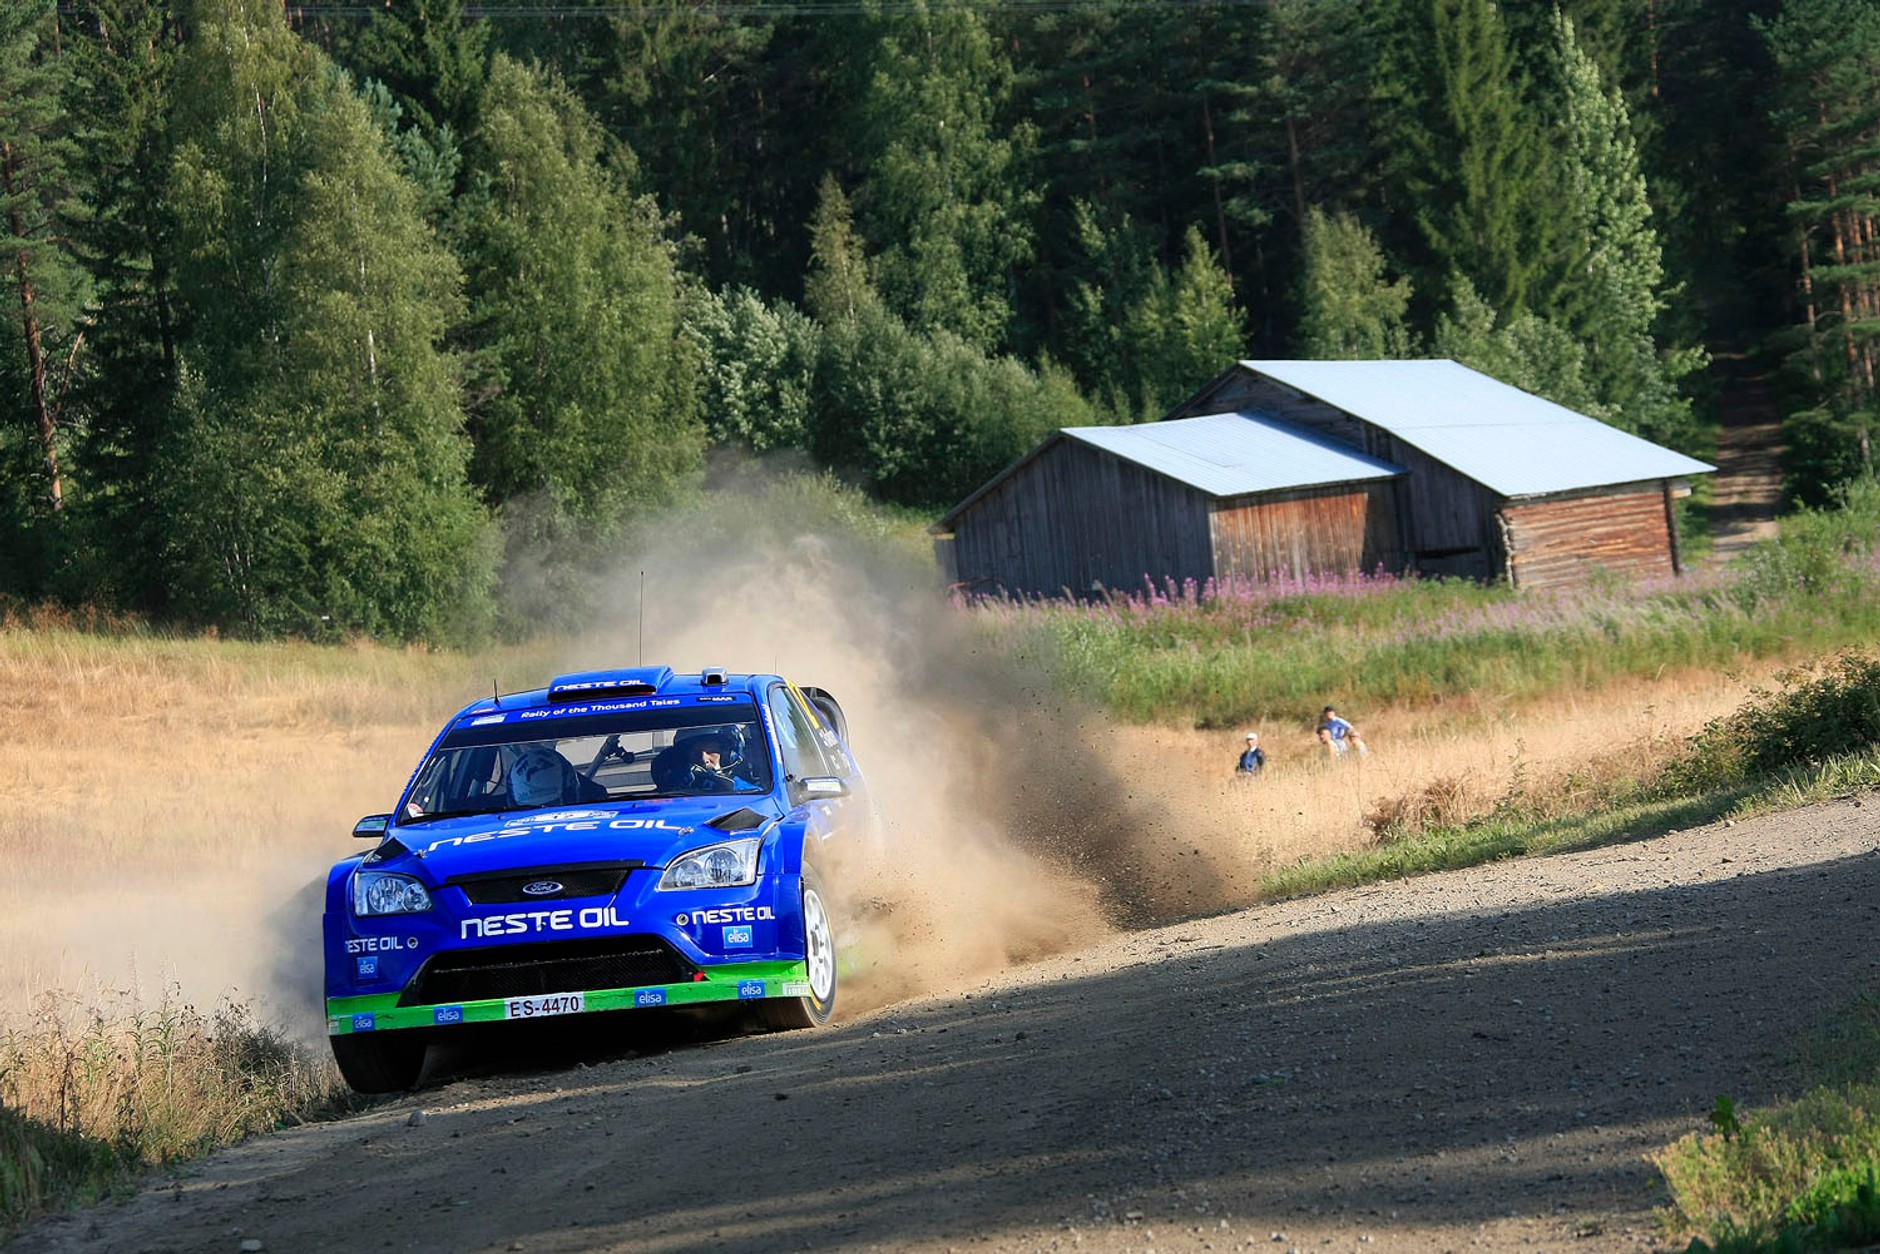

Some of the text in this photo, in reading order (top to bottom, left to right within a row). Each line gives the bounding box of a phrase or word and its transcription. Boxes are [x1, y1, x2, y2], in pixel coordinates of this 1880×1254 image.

[521, 709, 551, 719] Rally
[591, 701, 647, 712] Thousand
[650, 699, 681, 707] Tales
[428, 822, 598, 852] NESTE
[609, 819, 683, 831] OIL
[692, 905, 776, 925] NESTE OIL
[461, 907, 629, 940] NESTE OIL
[380, 936, 404, 950] OIL
[728, 928, 749, 943] elisa
[360, 960, 374, 974] elisa
[741, 981, 762, 996] elisa
[640, 990, 662, 1004] elisa
[437, 1006, 459, 1021] elisa
[510, 996, 579, 1017] ES-4470
[354, 1016, 372, 1029] elisa
